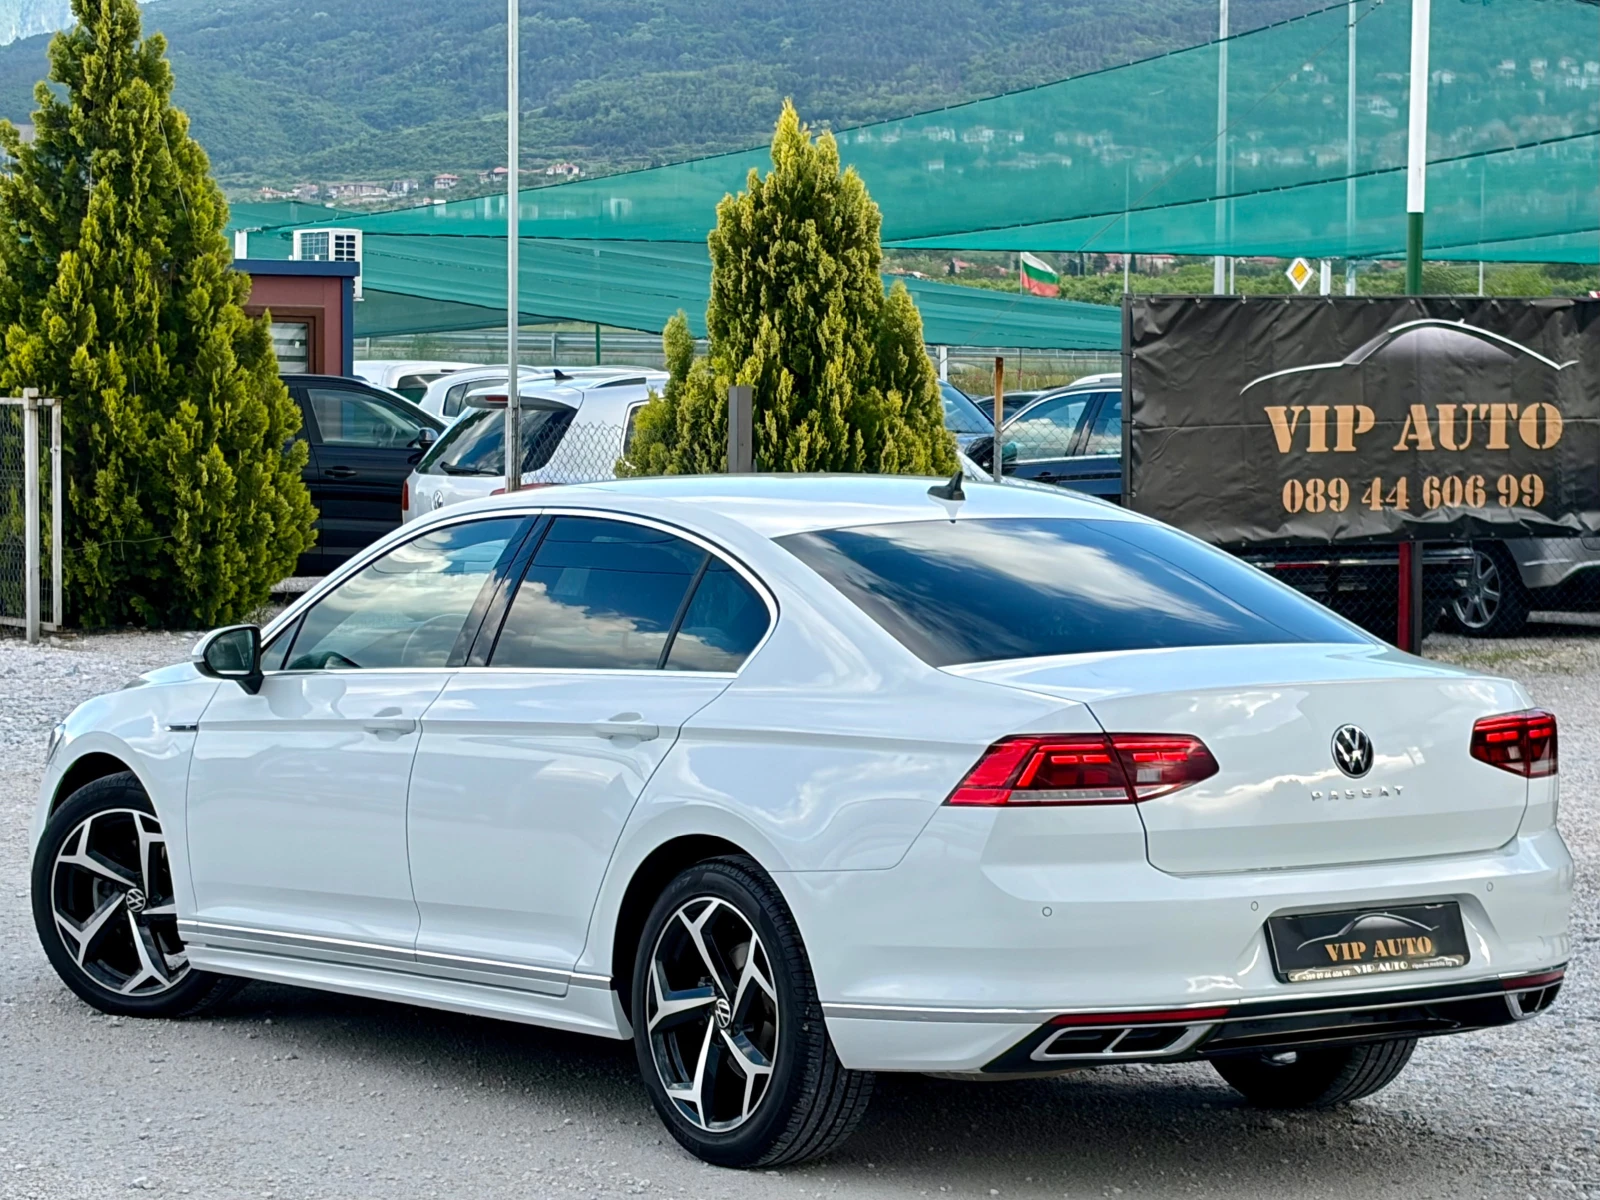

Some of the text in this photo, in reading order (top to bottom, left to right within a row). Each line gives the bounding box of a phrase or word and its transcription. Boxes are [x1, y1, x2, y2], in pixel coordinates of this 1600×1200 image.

[1264, 402, 1564, 453] VIP AUTO
[1282, 473, 1545, 513] 089 44 606 99
[1310, 785, 1404, 801] PASSAT
[1325, 936, 1432, 961] VIP AUTO
[1353, 964, 1375, 974] VIP
[1377, 961, 1408, 972] AUTO
